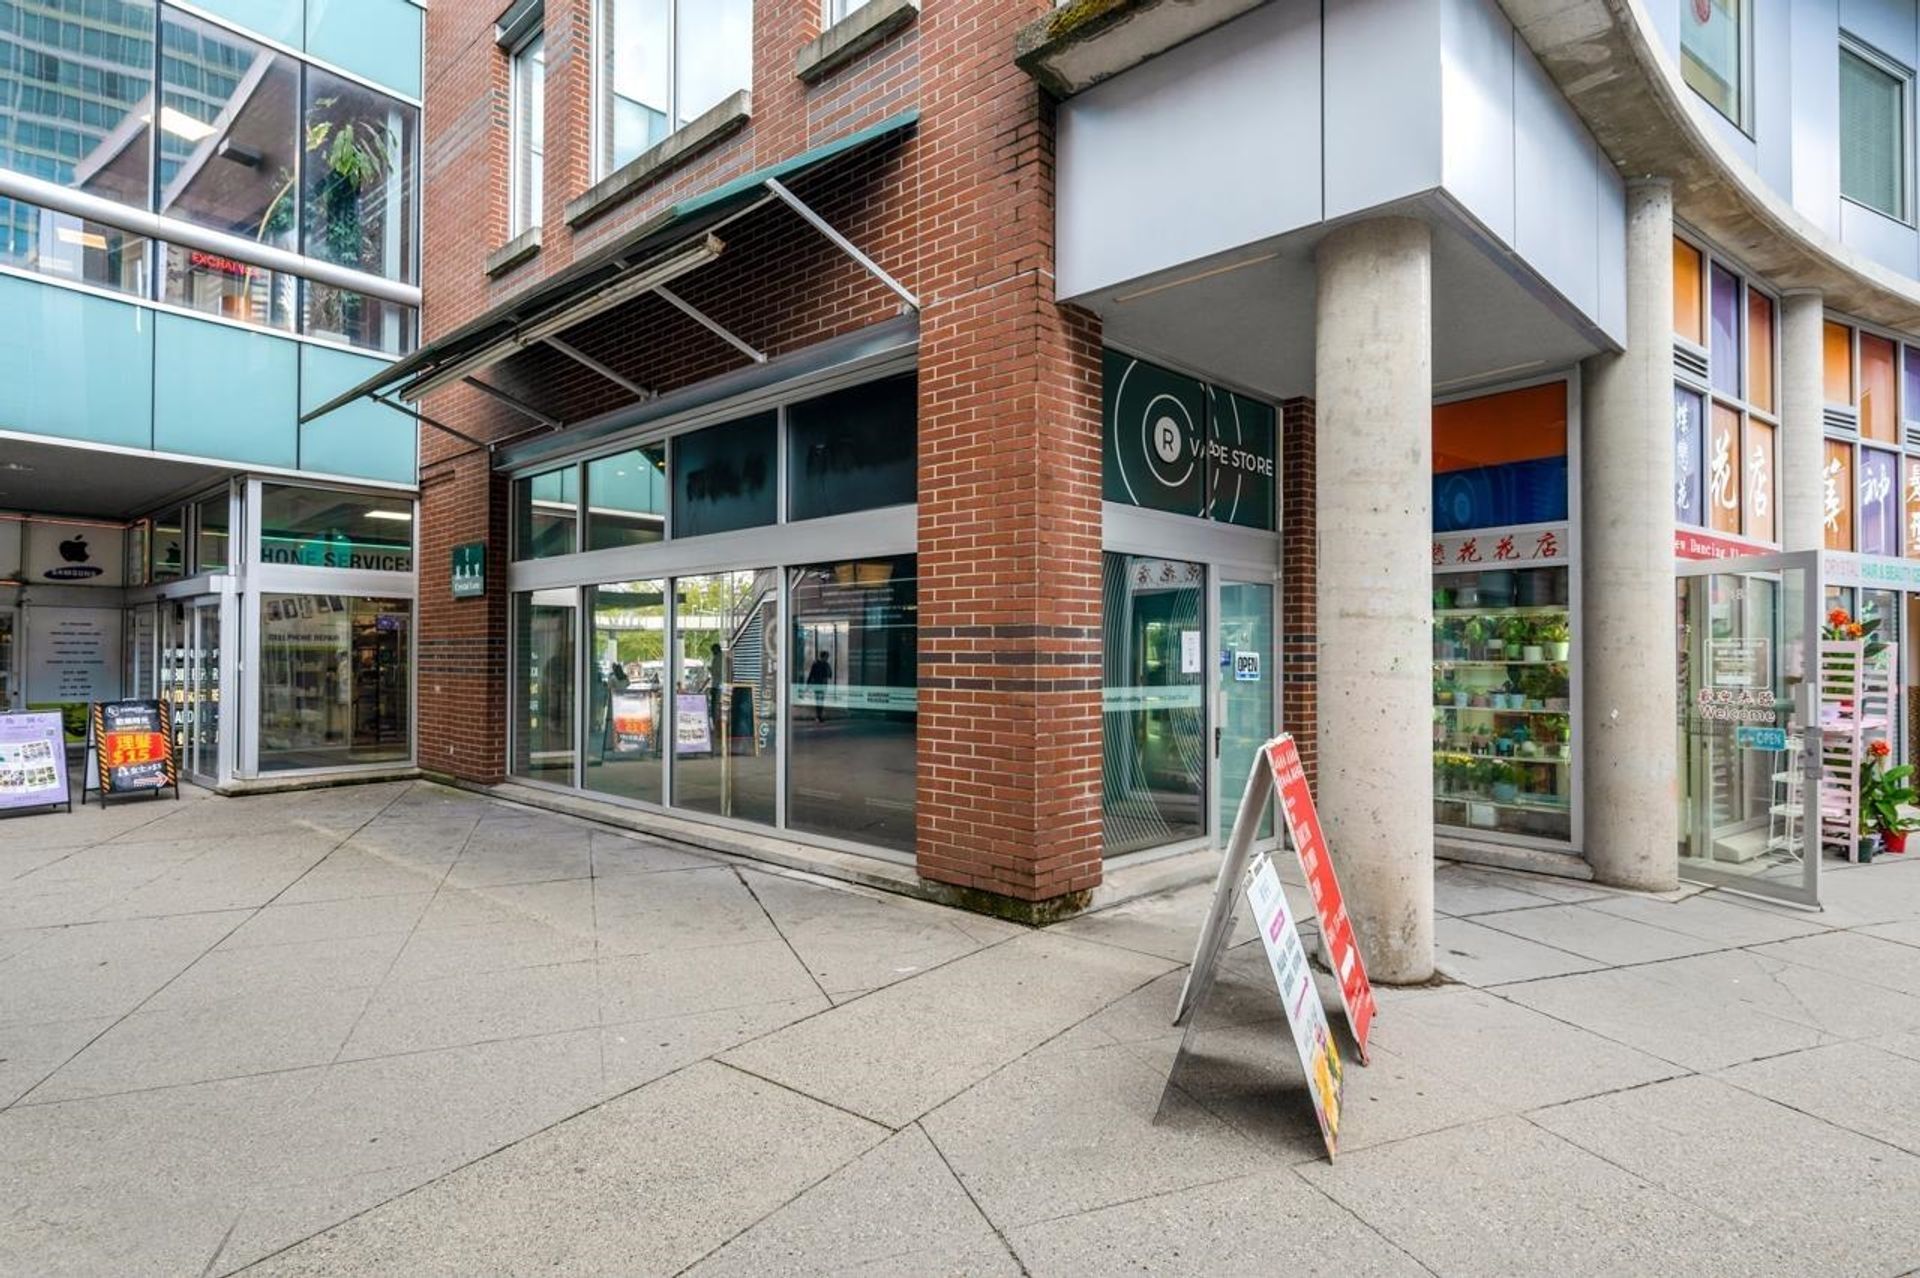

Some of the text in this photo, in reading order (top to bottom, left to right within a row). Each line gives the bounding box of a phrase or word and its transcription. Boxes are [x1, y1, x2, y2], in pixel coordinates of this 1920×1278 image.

[1163, 428, 1174, 452] R
[1190, 437, 1273, 476] VAPE STORE
[1690, 538, 1726, 560] Dancing
[1238, 656, 1258, 673] OPEN
[1698, 704, 1776, 722] Welcome
[1756, 731, 1781, 745] OPEN
[112, 748, 151, 765] $15
